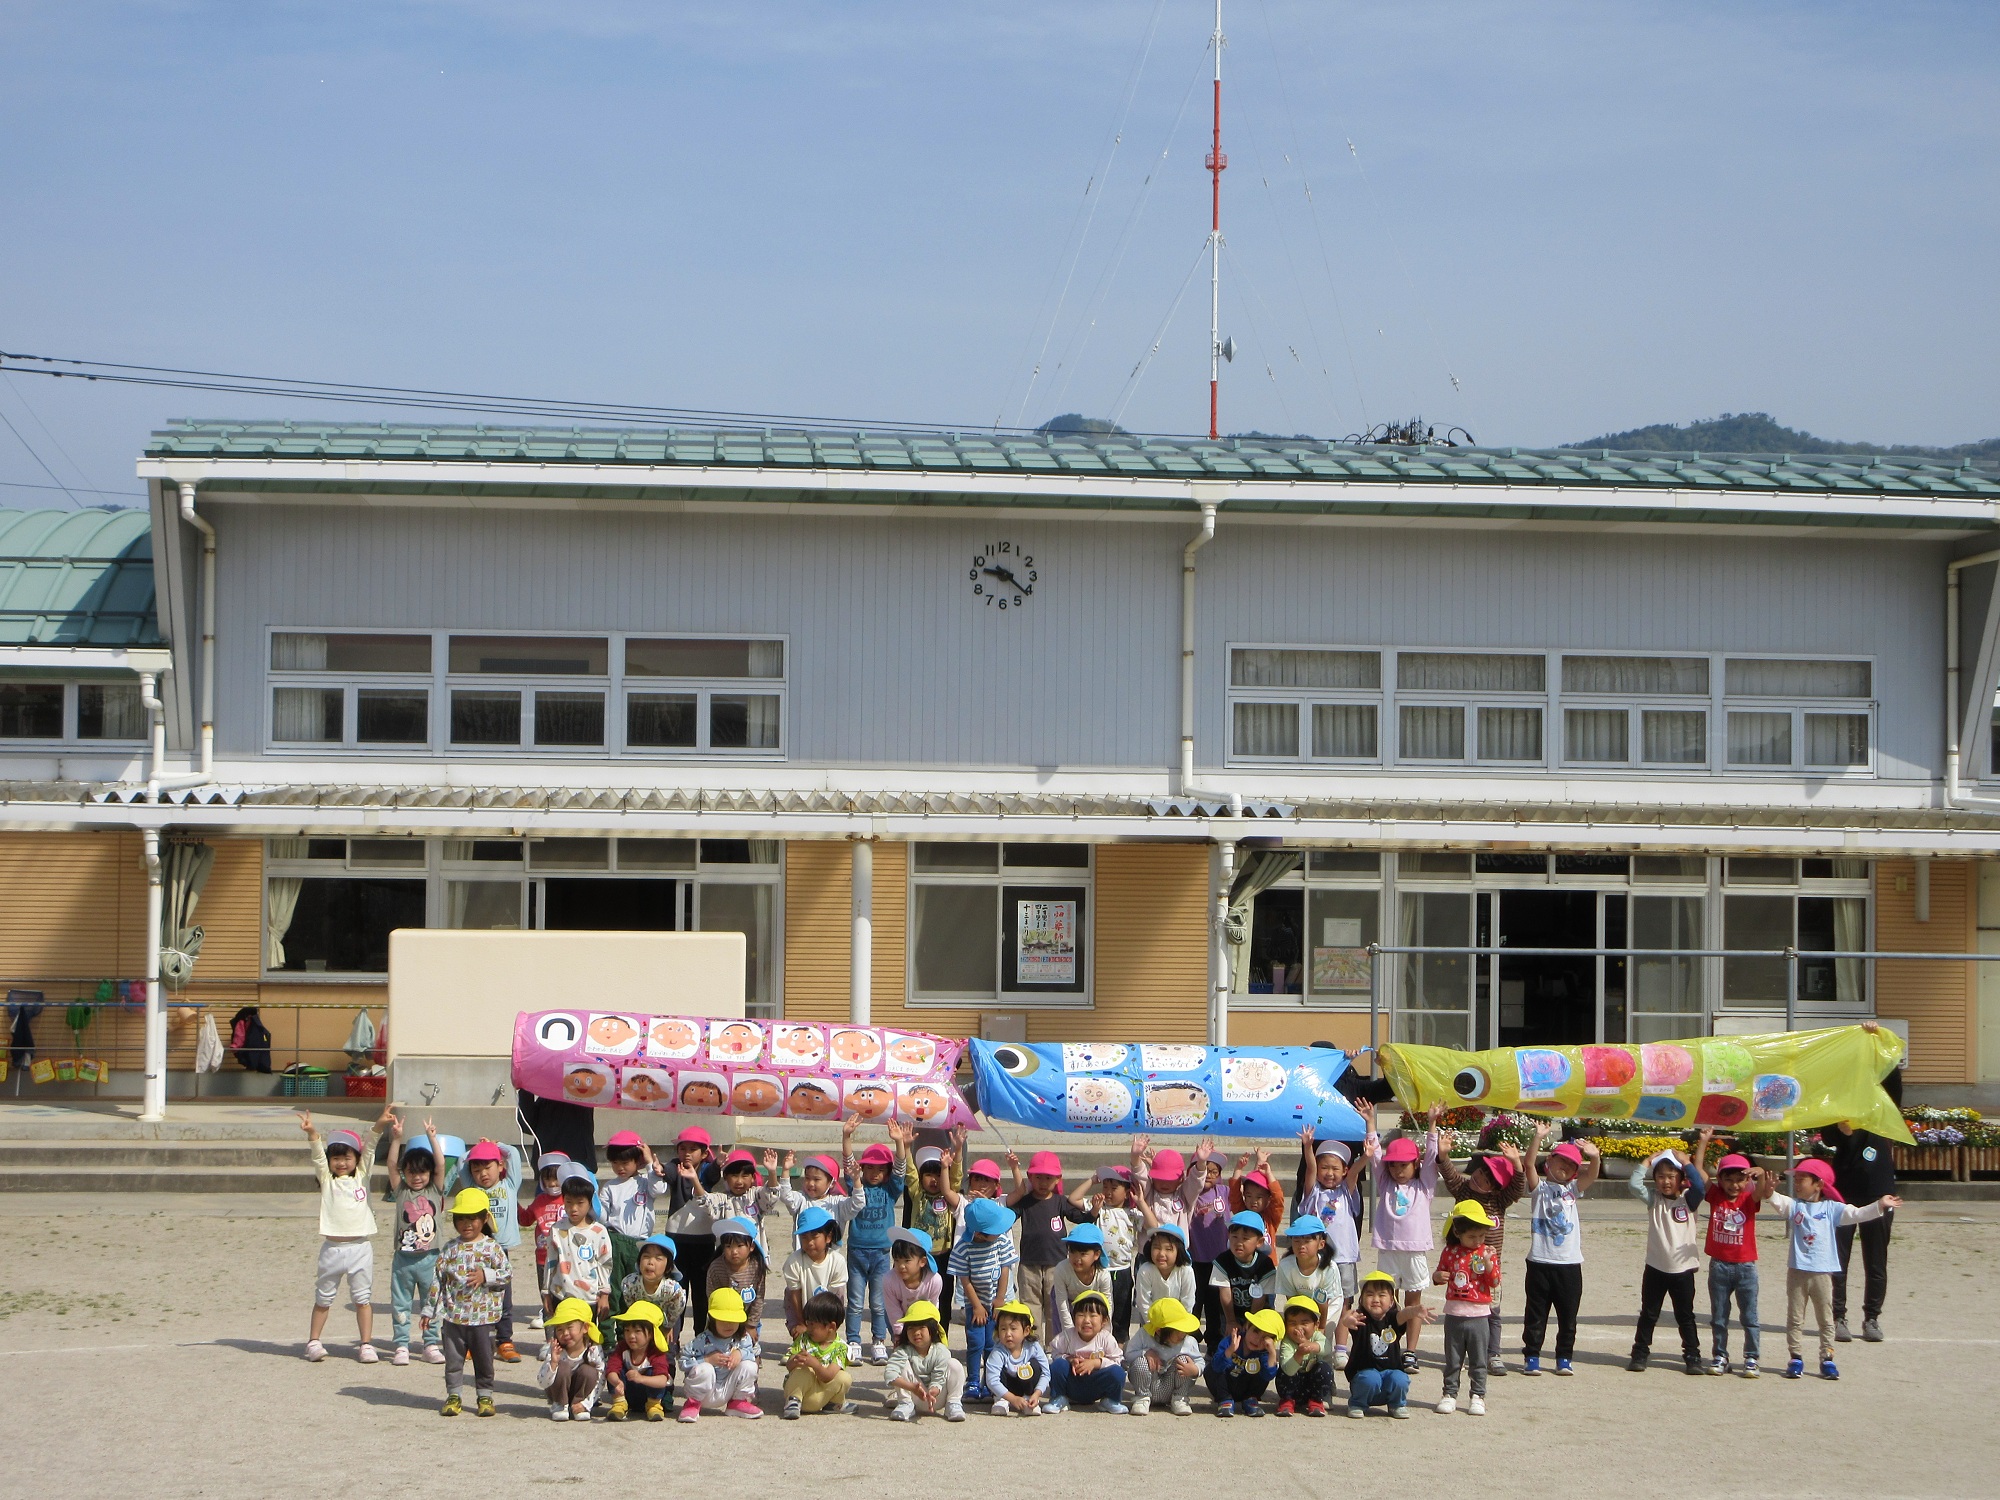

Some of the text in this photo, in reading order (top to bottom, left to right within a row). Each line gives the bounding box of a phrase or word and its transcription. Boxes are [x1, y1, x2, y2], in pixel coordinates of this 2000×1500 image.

[985, 544, 994, 556] 11
[998, 541, 1011, 553] 12
[973, 556, 985, 567] 10
[1025, 556, 1033, 567] 2
[969, 569, 978, 581] 9
[1029, 570, 1038, 582] 3
[974, 583, 983, 595] 8
[1024, 584, 1033, 595] 4
[985, 594, 994, 606] 7
[998, 598, 1007, 610] 6
[1013, 595, 1022, 607] 5
[1713, 1231, 1744, 1245] TROUBLE
